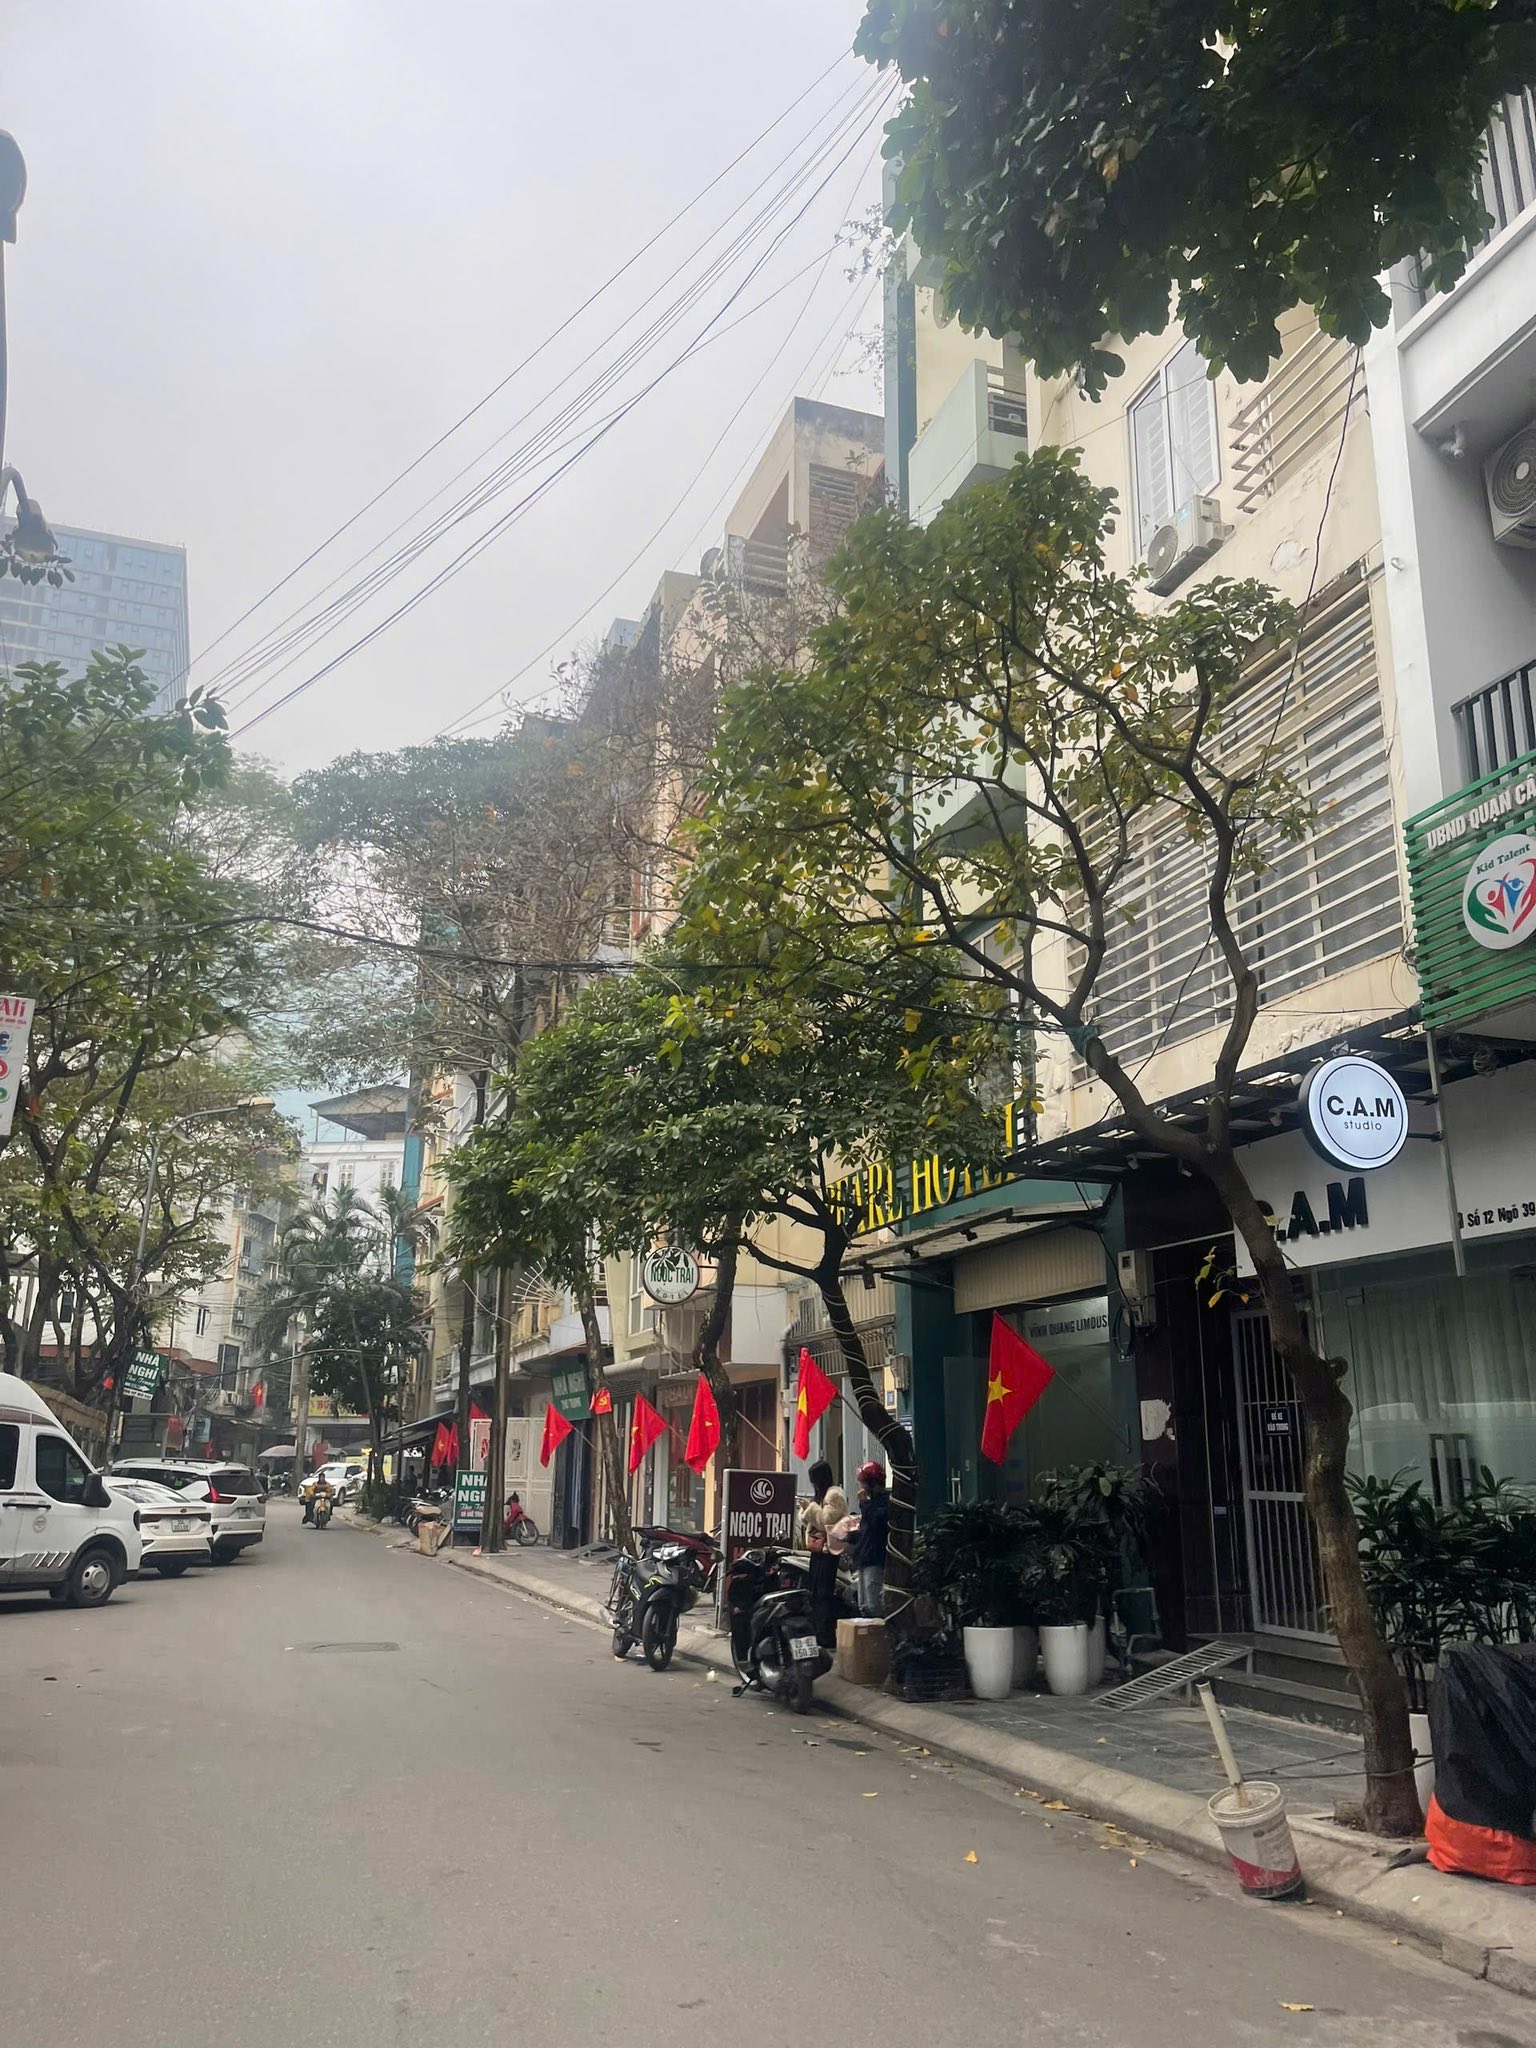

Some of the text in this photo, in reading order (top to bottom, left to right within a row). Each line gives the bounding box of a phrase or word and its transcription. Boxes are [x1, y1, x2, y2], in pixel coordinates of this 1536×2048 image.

[1427, 815, 1466, 850] UBND
[1469, 789, 1512, 829] QUẬN
[1477, 843, 1530, 875] Kid Talent
[1326, 1095, 1395, 1118] C.A.M
[1344, 1120, 1382, 1131] studio
[1467, 1208, 1480, 1227] Số
[1482, 1210, 1495, 1225] 12
[1497, 1204, 1519, 1223] Ngõ
[1522, 1202, 1536, 1217] 39
[676, 1267, 694, 1283] TRAI
[1049, 1320, 1075, 1336] QUANG
[729, 1511, 791, 1543] NGỌC TRAI
